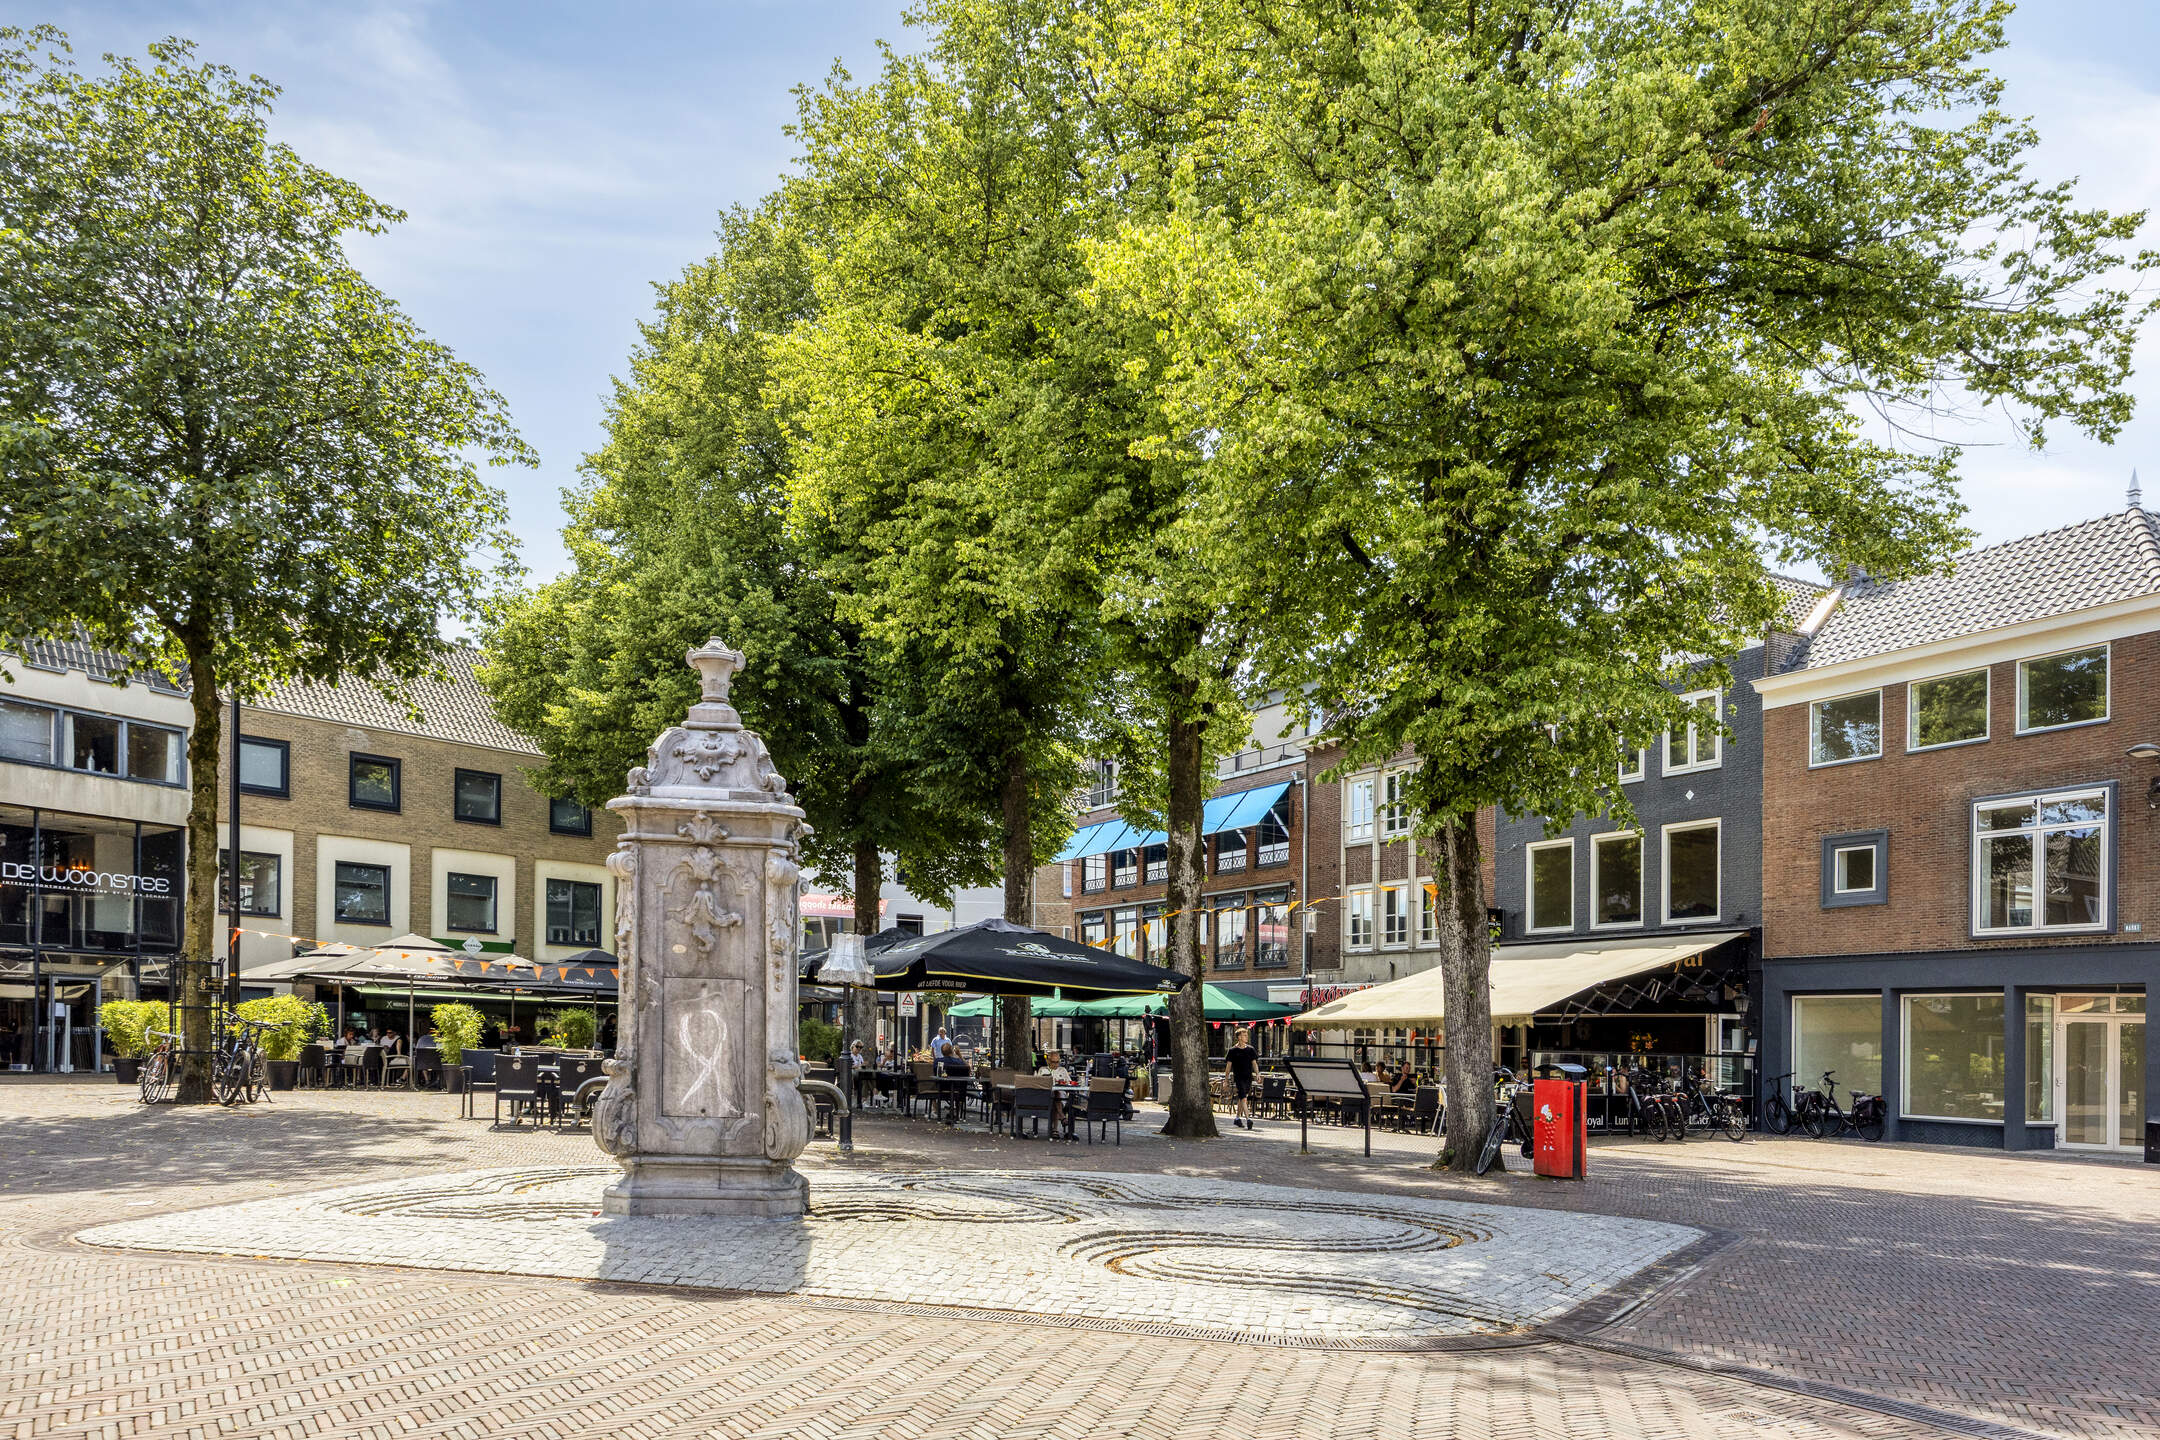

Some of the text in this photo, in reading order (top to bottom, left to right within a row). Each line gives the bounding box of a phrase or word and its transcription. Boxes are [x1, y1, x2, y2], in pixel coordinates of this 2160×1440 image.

[2, 862, 170, 893] DE WOONSTEE
[1661, 951, 1703, 973] yal
[1586, 1114, 1604, 1128] oyal
